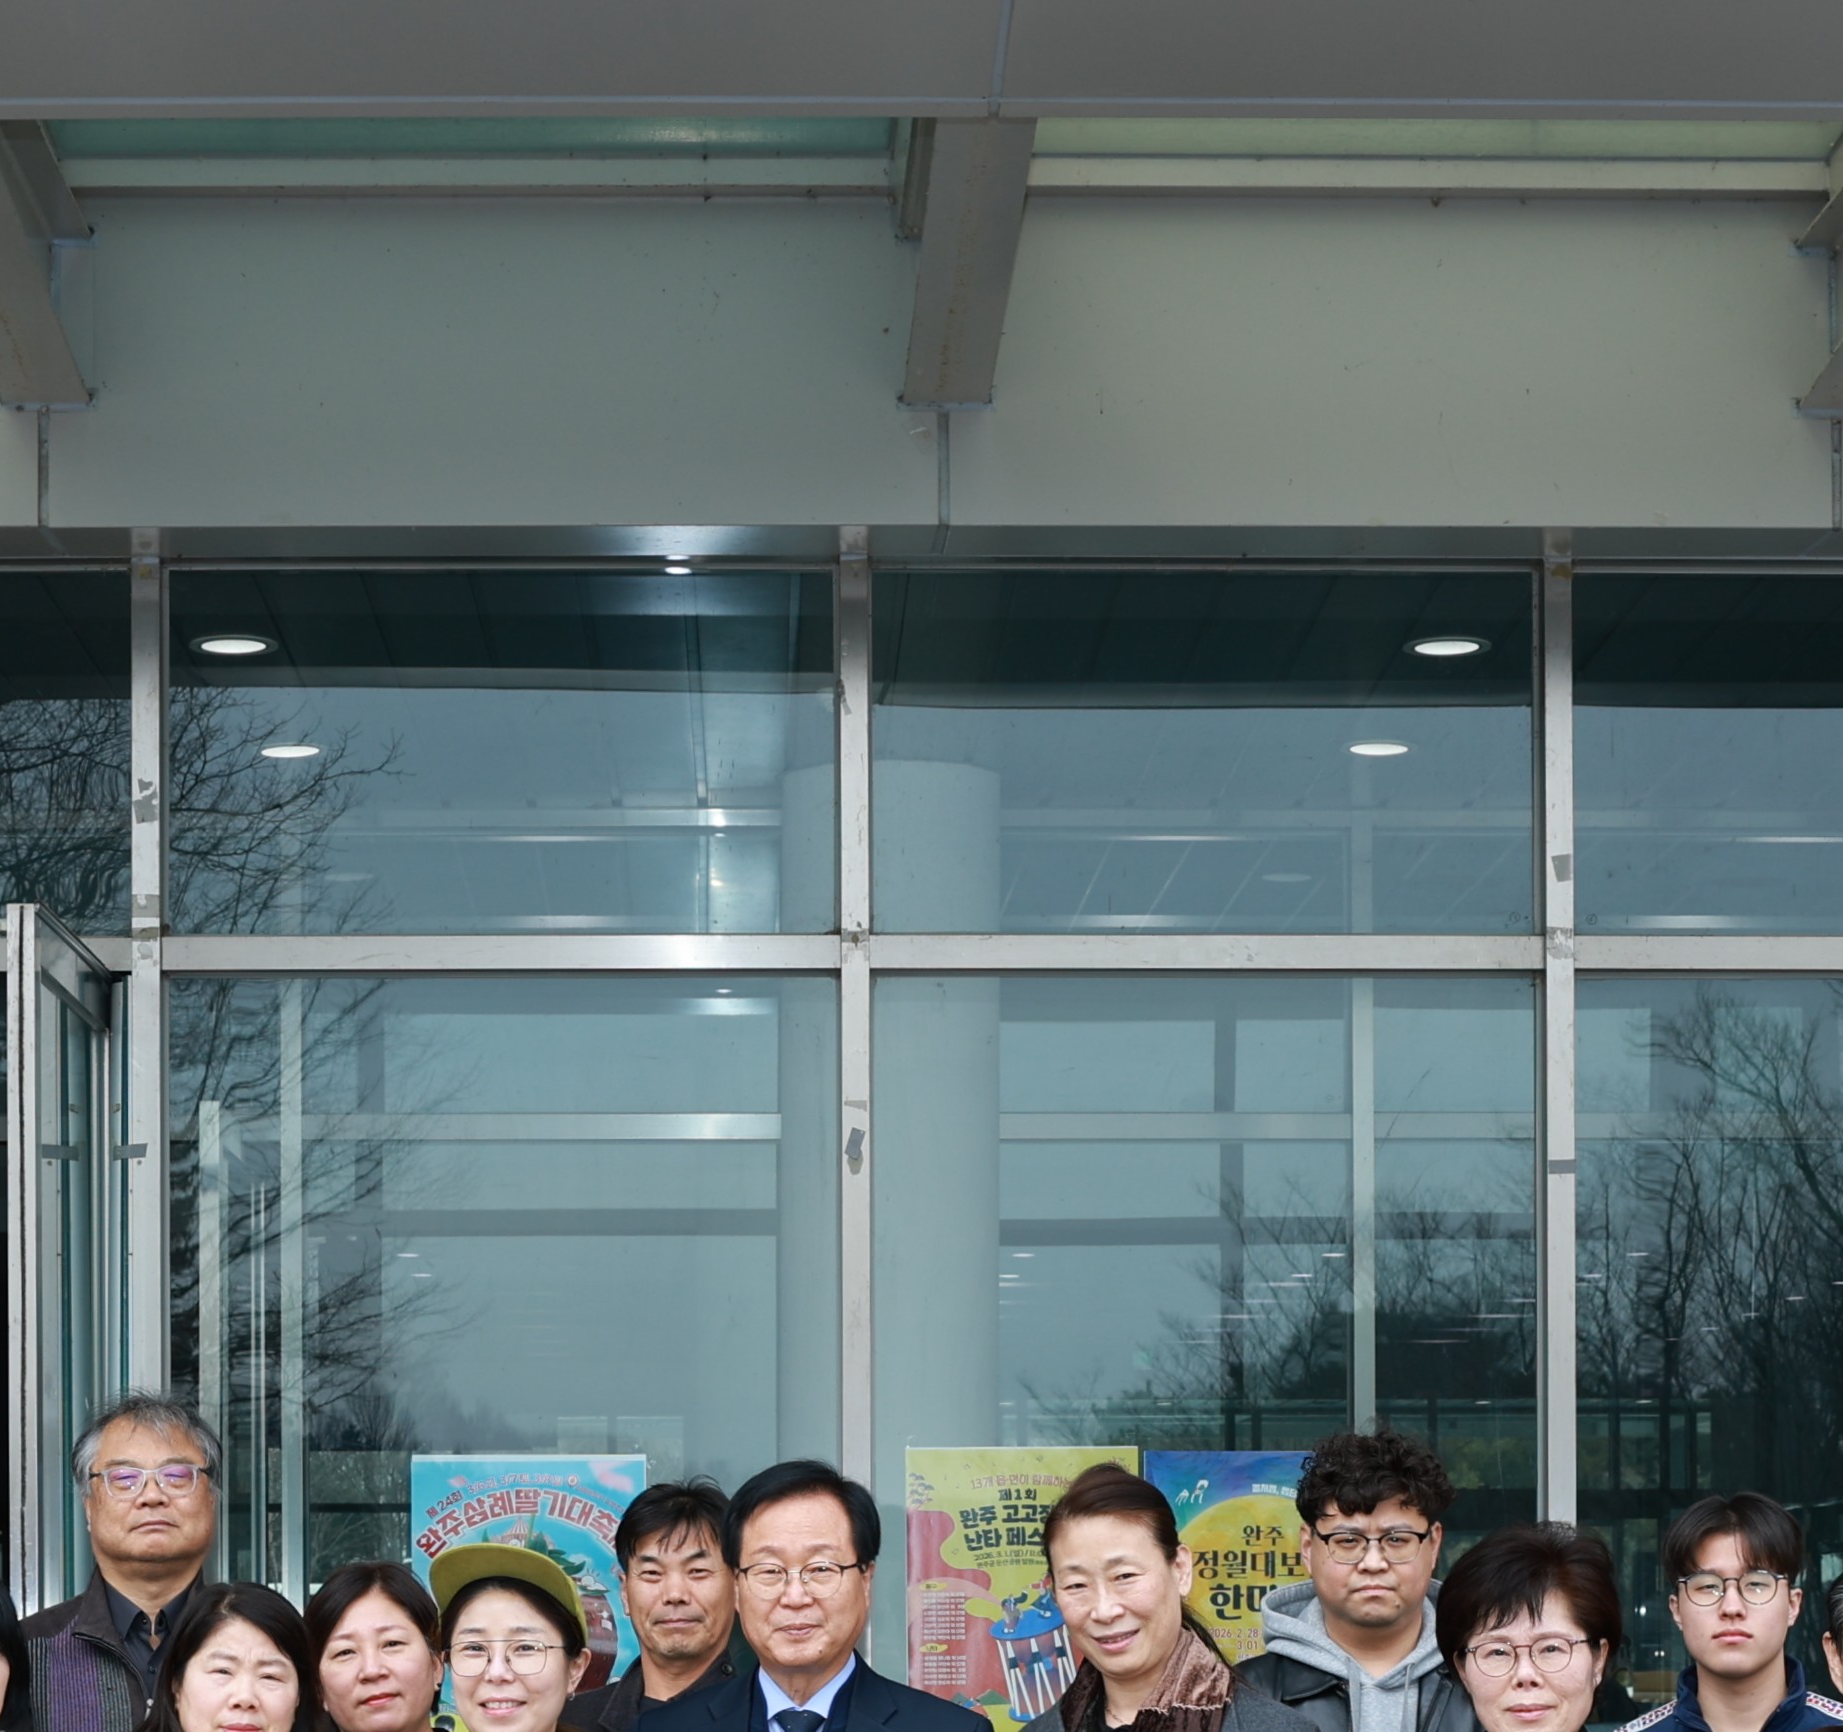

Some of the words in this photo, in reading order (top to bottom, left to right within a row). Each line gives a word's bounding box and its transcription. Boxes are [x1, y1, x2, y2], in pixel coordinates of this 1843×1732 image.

[415, 1488, 624, 1560] 완주삼례딸기대축
[959, 1505, 998, 1530] 완주
[963, 1526, 1003, 1551] 난타
[1241, 1525, 1285, 1547] 완주
